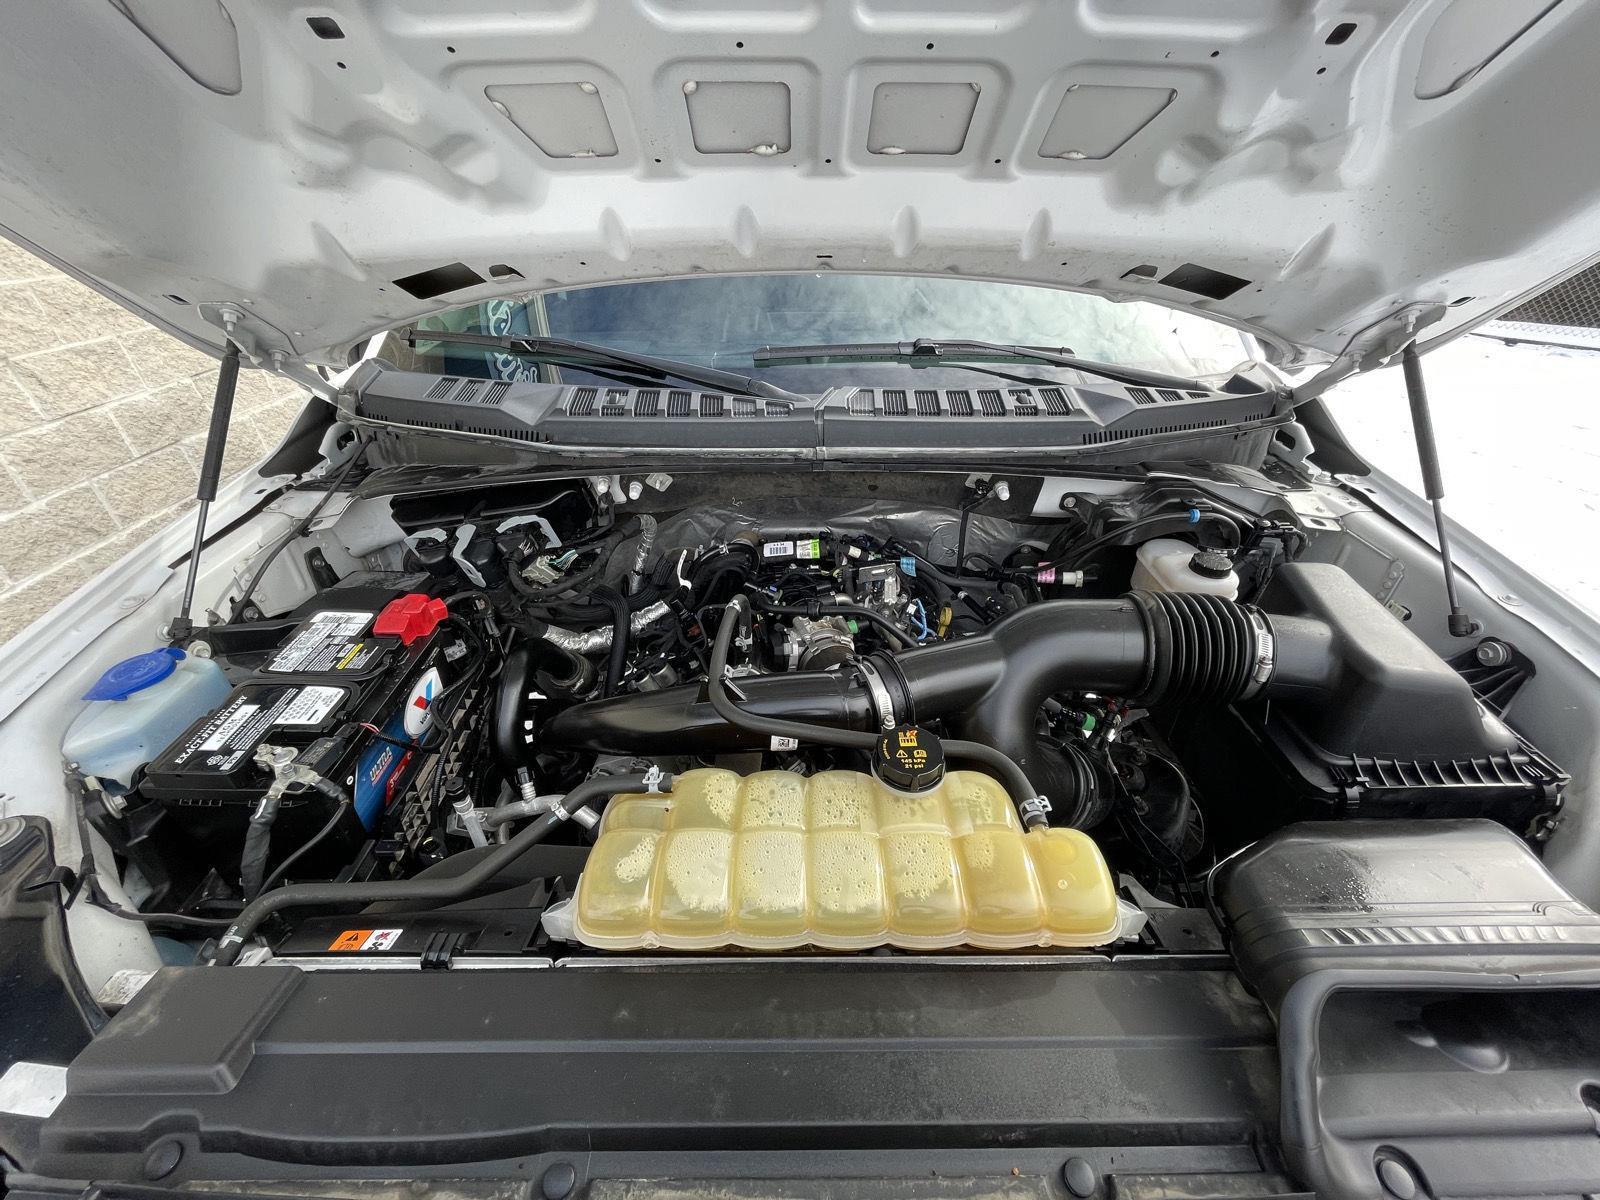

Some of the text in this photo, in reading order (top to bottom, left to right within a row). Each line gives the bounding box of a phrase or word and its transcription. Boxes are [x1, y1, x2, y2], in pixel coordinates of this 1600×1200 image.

[174, 725, 217, 764] EXACT-FIT
[215, 695, 248, 726] BATTERY
[370, 746, 393, 782] ULTRA
